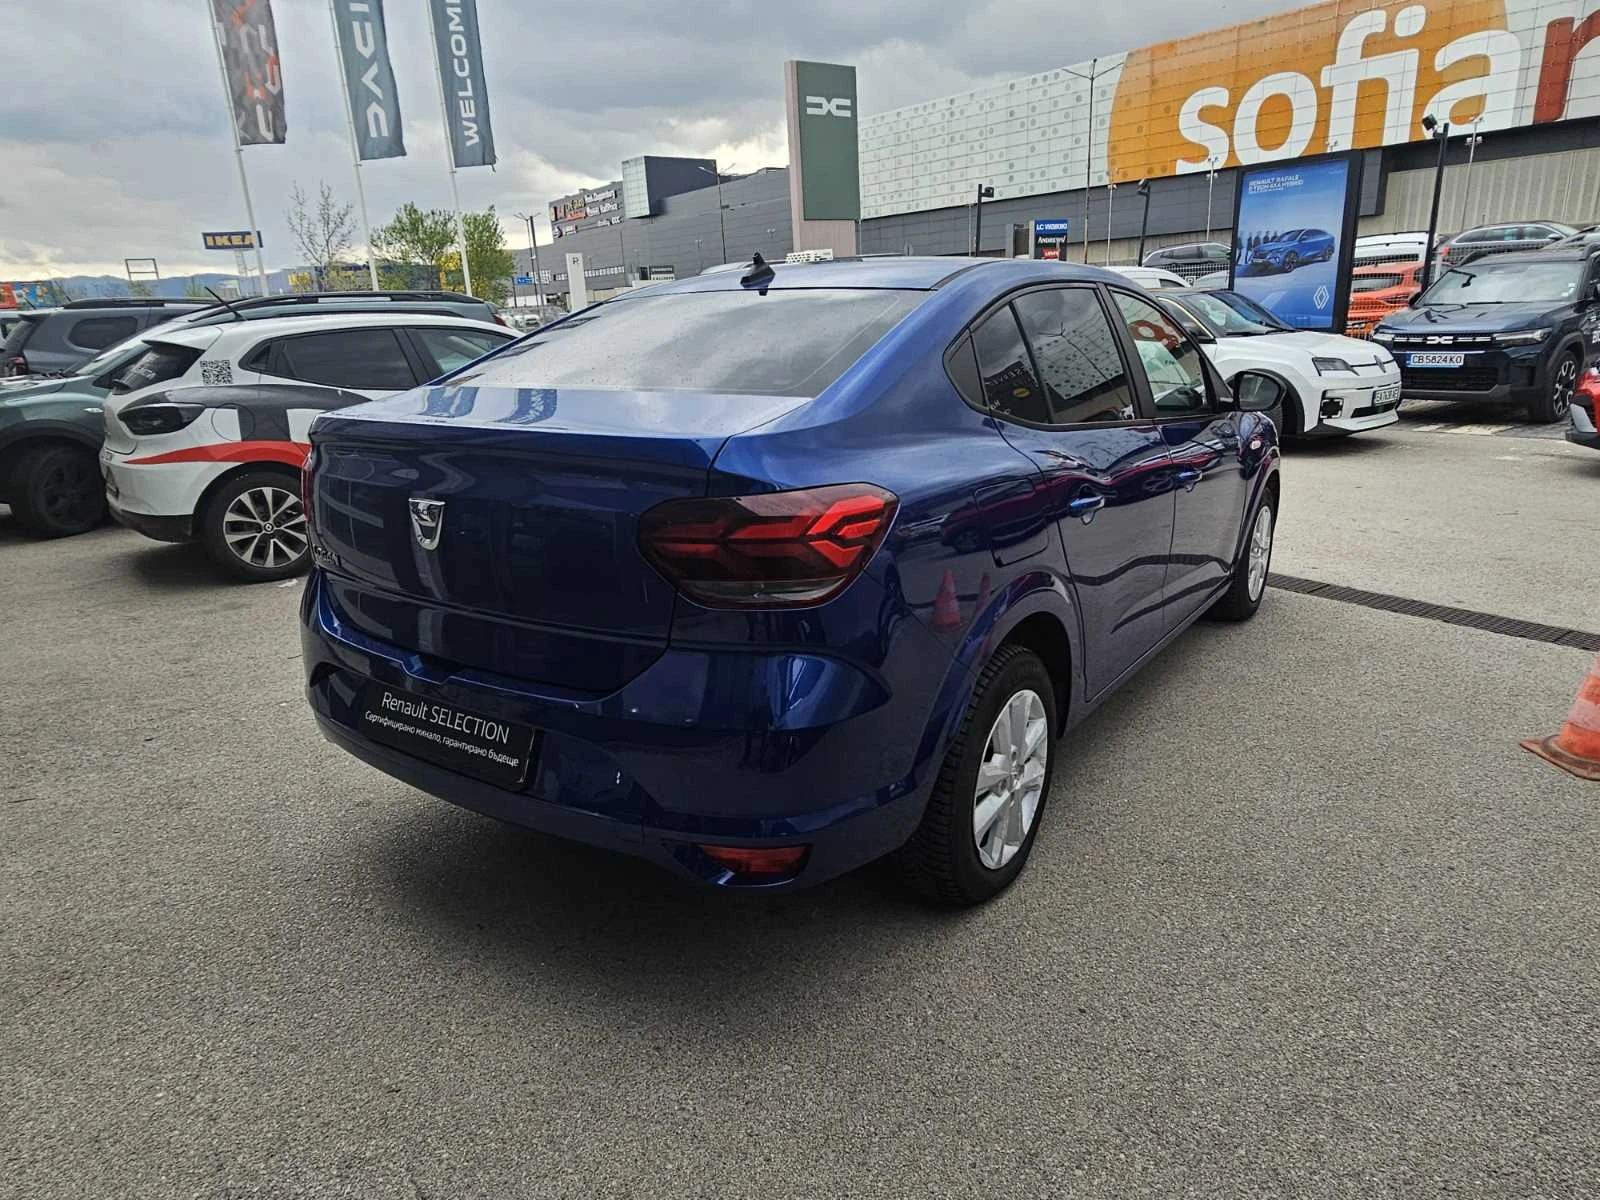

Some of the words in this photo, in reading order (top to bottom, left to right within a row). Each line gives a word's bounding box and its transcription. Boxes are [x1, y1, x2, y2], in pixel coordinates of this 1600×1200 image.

[447, 0, 479, 147] WELCOM
[206, 234, 257, 246] IKEA
[381, 691, 429, 720] Renault
[429, 705, 510, 744] SELECTION
[442, 736, 488, 757] гарантирано
[488, 749, 520, 767] бъдеще
